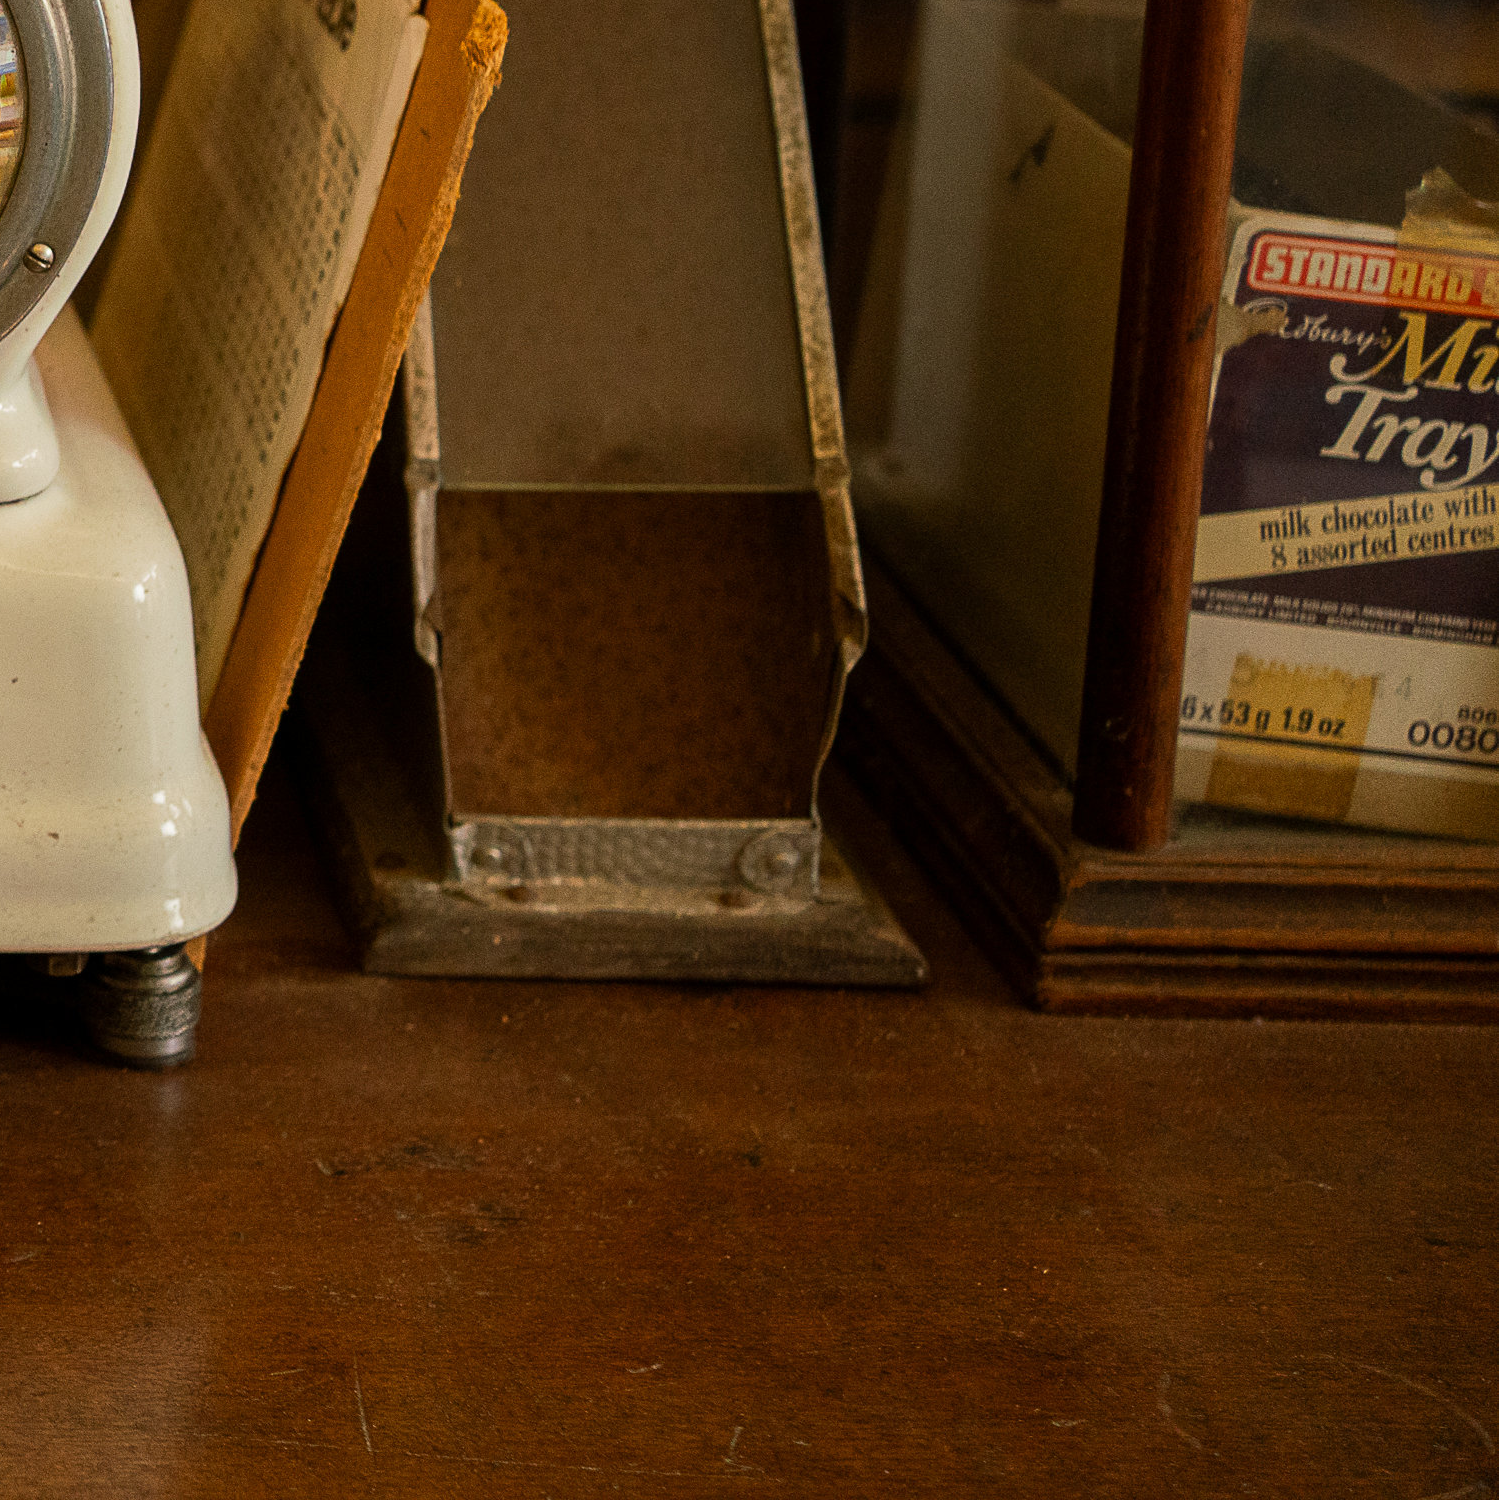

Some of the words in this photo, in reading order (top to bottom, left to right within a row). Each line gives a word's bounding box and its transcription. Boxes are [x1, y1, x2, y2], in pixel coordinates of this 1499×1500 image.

[1263, 244, 1474, 305] STANDARD
[1259, 506, 1312, 543] milk
[1320, 495, 1436, 535] chocolate
[1443, 486, 1498, 522] with
[1270, 544, 1287, 569] 8
[1295, 526, 1399, 567] assorted
[1407, 515, 1497, 553] centres
[1200, 704, 1213, 724] x
[1219, 697, 1251, 729] 53
[1254, 707, 1272, 734] g
[1282, 704, 1315, 736] 1.9
[1317, 714, 1347, 738] oz
[1407, 719, 1499, 757] 0080
